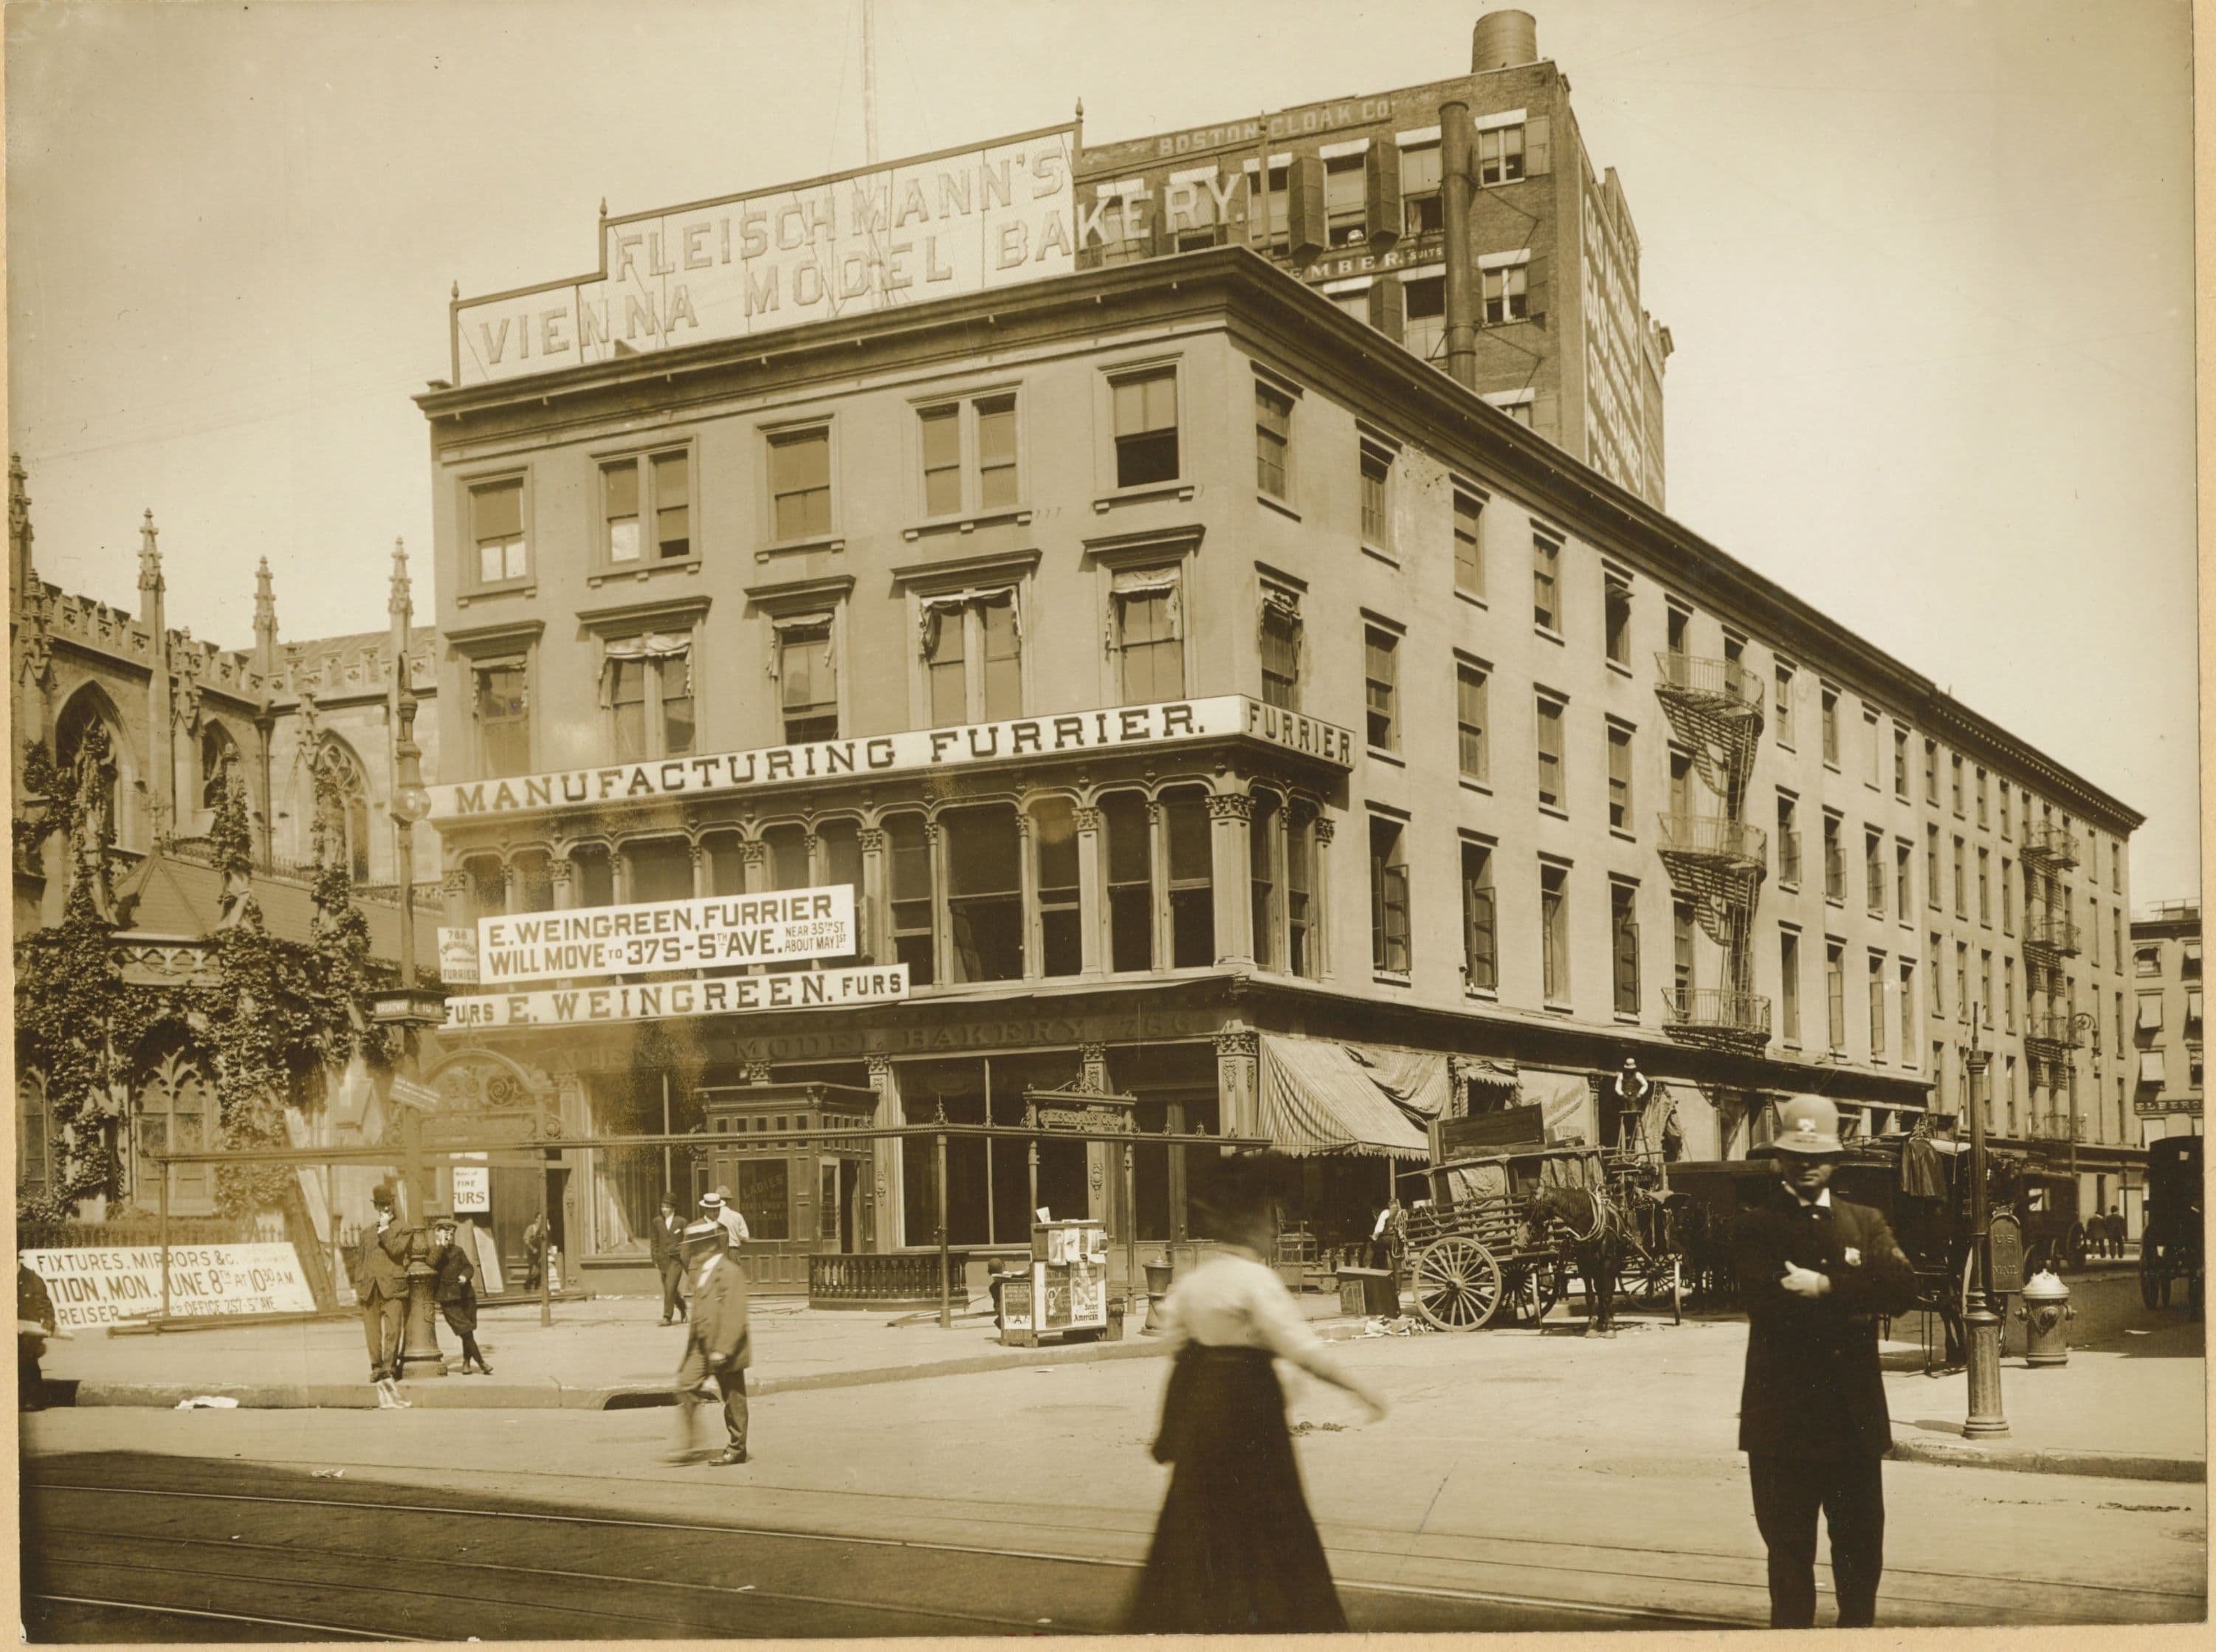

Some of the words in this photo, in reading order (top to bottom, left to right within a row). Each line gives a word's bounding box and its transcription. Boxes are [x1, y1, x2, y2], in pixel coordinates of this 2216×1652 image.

[1159, 121, 1260, 157] BOSTON
[1270, 101, 1352, 137] CLOAK
[615, 146, 1064, 283] FLEISCHMANN'S
[479, 283, 699, 365] VIENNA
[743, 235, 953, 317] MODEL
[996, 171, 1246, 272] BAKERY.
[1248, 701, 1352, 765] FURRIER
[455, 738, 896, 814] MANUFACTURING
[929, 703, 1205, 763] FURRIER.
[703, 895, 832, 929] FURRIER
[785, 925, 809, 937] NEAR
[785, 938, 813, 953] ABOUT
[816, 936, 834, 950] MAY
[489, 947, 540, 977] WILL
[545, 943, 606, 972] MOVE
[444, 1002, 495, 1024] FURS
[507, 996, 538, 1025] E.
[551, 974, 833, 1022] WEINGREEN.
[842, 973, 902, 997] FURS
[904, 1018, 1085, 1047] BAKERY
[452, 1191, 485, 1205] FURS
[132, 1250, 212, 1270] MIRRORS
[1992, 1264, 2020, 1276] MAIL
[158, 1270, 209, 1298] UNE
[235, 1274, 247, 1287] AT
[59, 1305, 120, 1326] REISER
